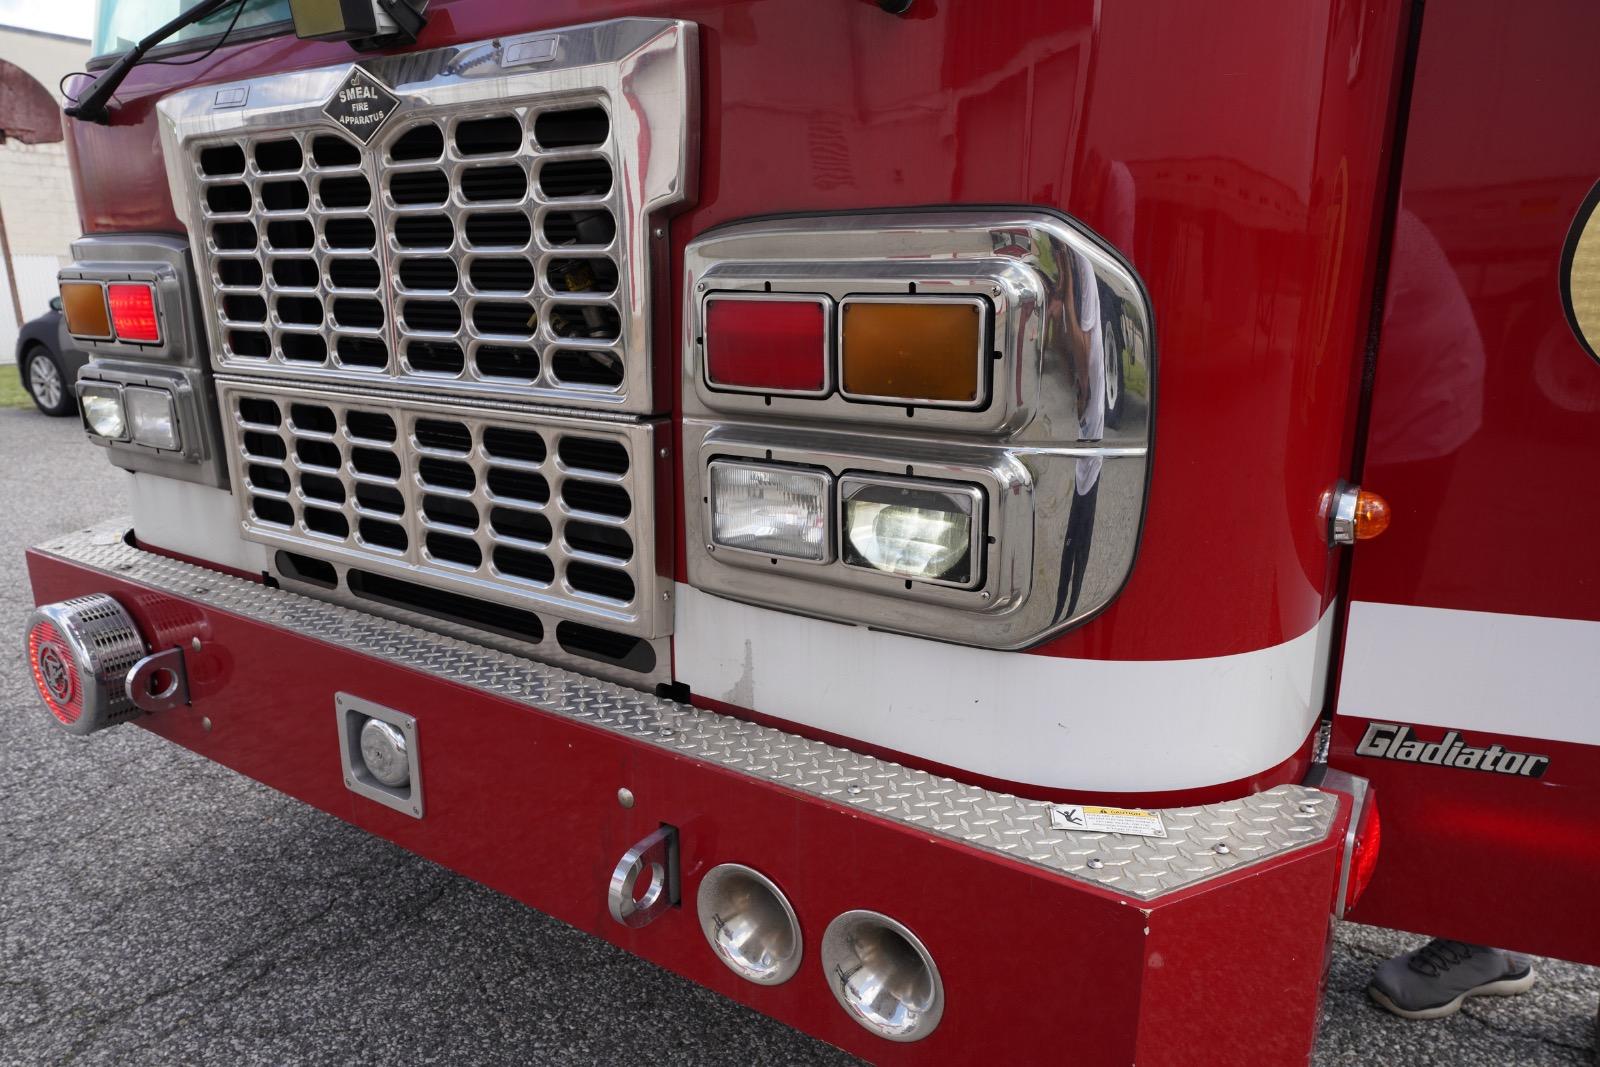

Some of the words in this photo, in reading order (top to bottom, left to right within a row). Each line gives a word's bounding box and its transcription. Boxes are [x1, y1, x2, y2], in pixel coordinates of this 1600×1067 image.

[339, 86, 378, 103] SMEAL
[351, 102, 369, 112] FIRE
[339, 110, 384, 125] APPARATUS
[1355, 722, 1550, 776] Gladiator
